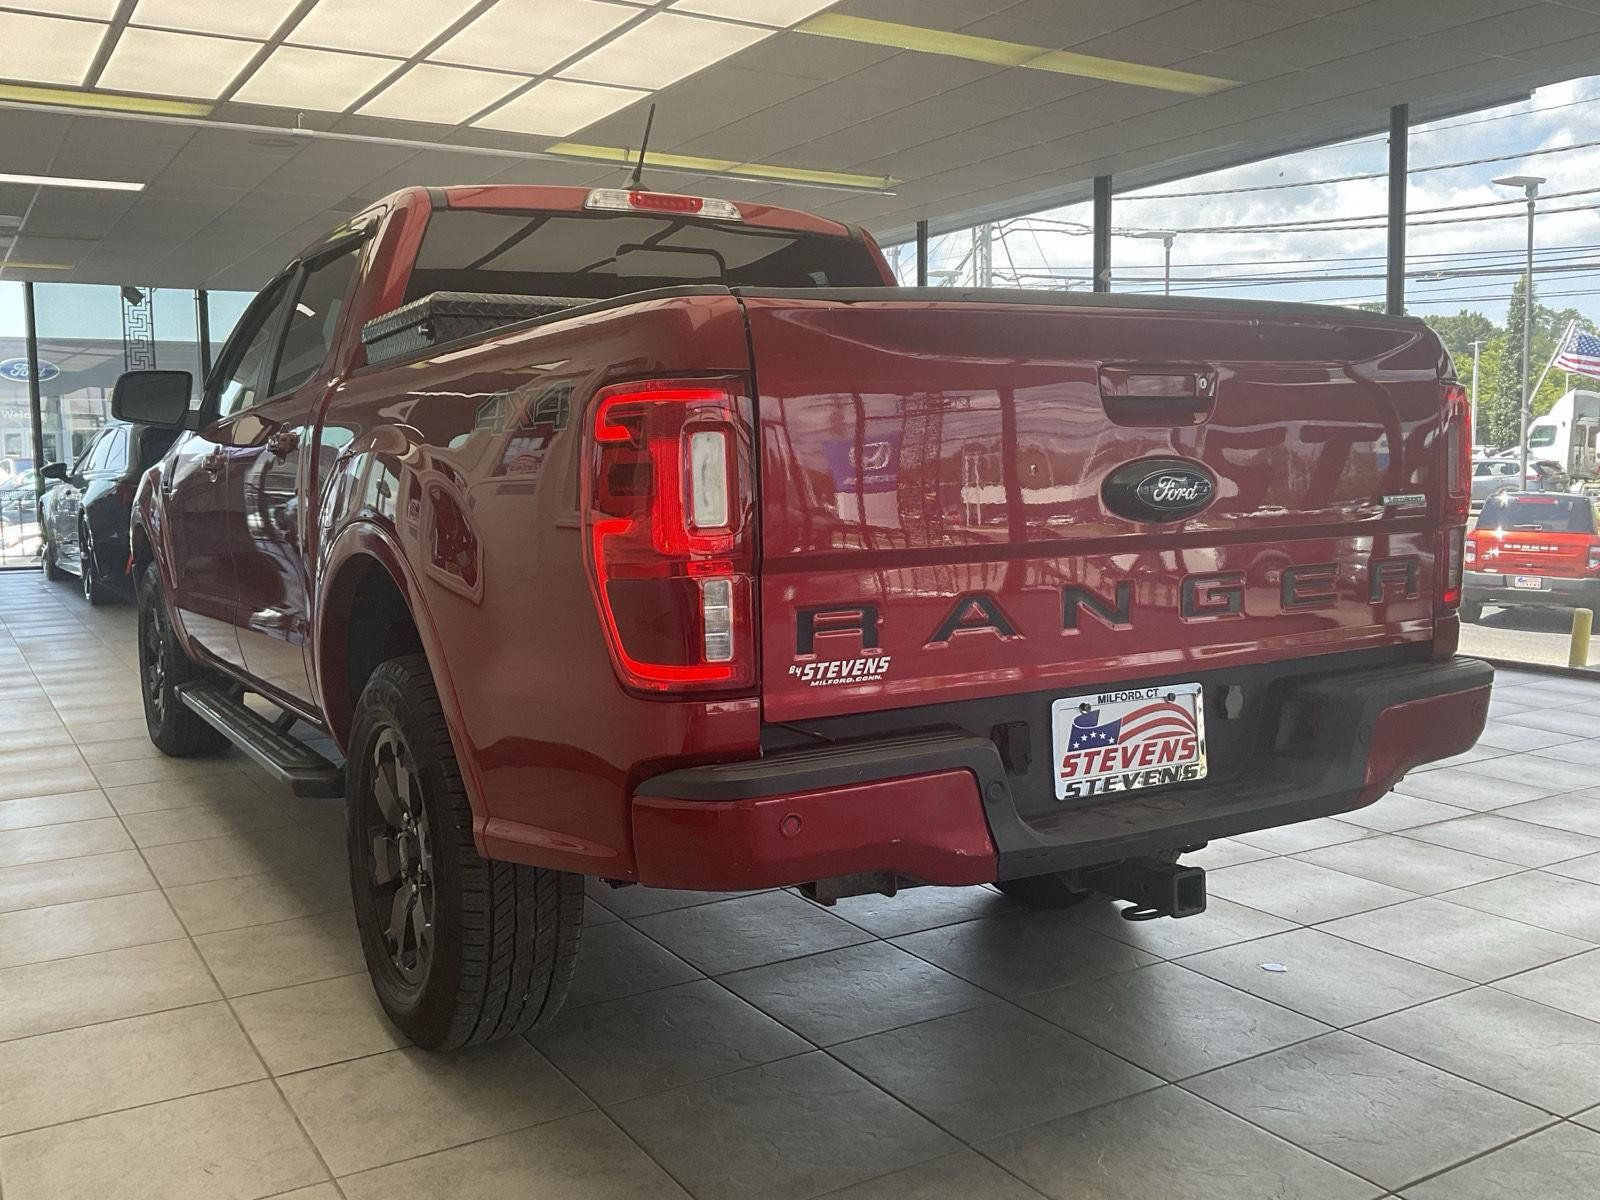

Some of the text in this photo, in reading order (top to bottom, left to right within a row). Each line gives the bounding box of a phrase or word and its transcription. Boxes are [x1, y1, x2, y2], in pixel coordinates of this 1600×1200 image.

[1153, 476, 1198, 501] Ford
[795, 556, 1419, 660] RANGER
[801, 656, 891, 680] STEVENS
[811, 678, 854, 687] MILFORD,
[1098, 689, 1159, 704] MILFORD, CT
[1060, 737, 1198, 778] STEVENS
[1063, 763, 1200, 799] STEVENS
